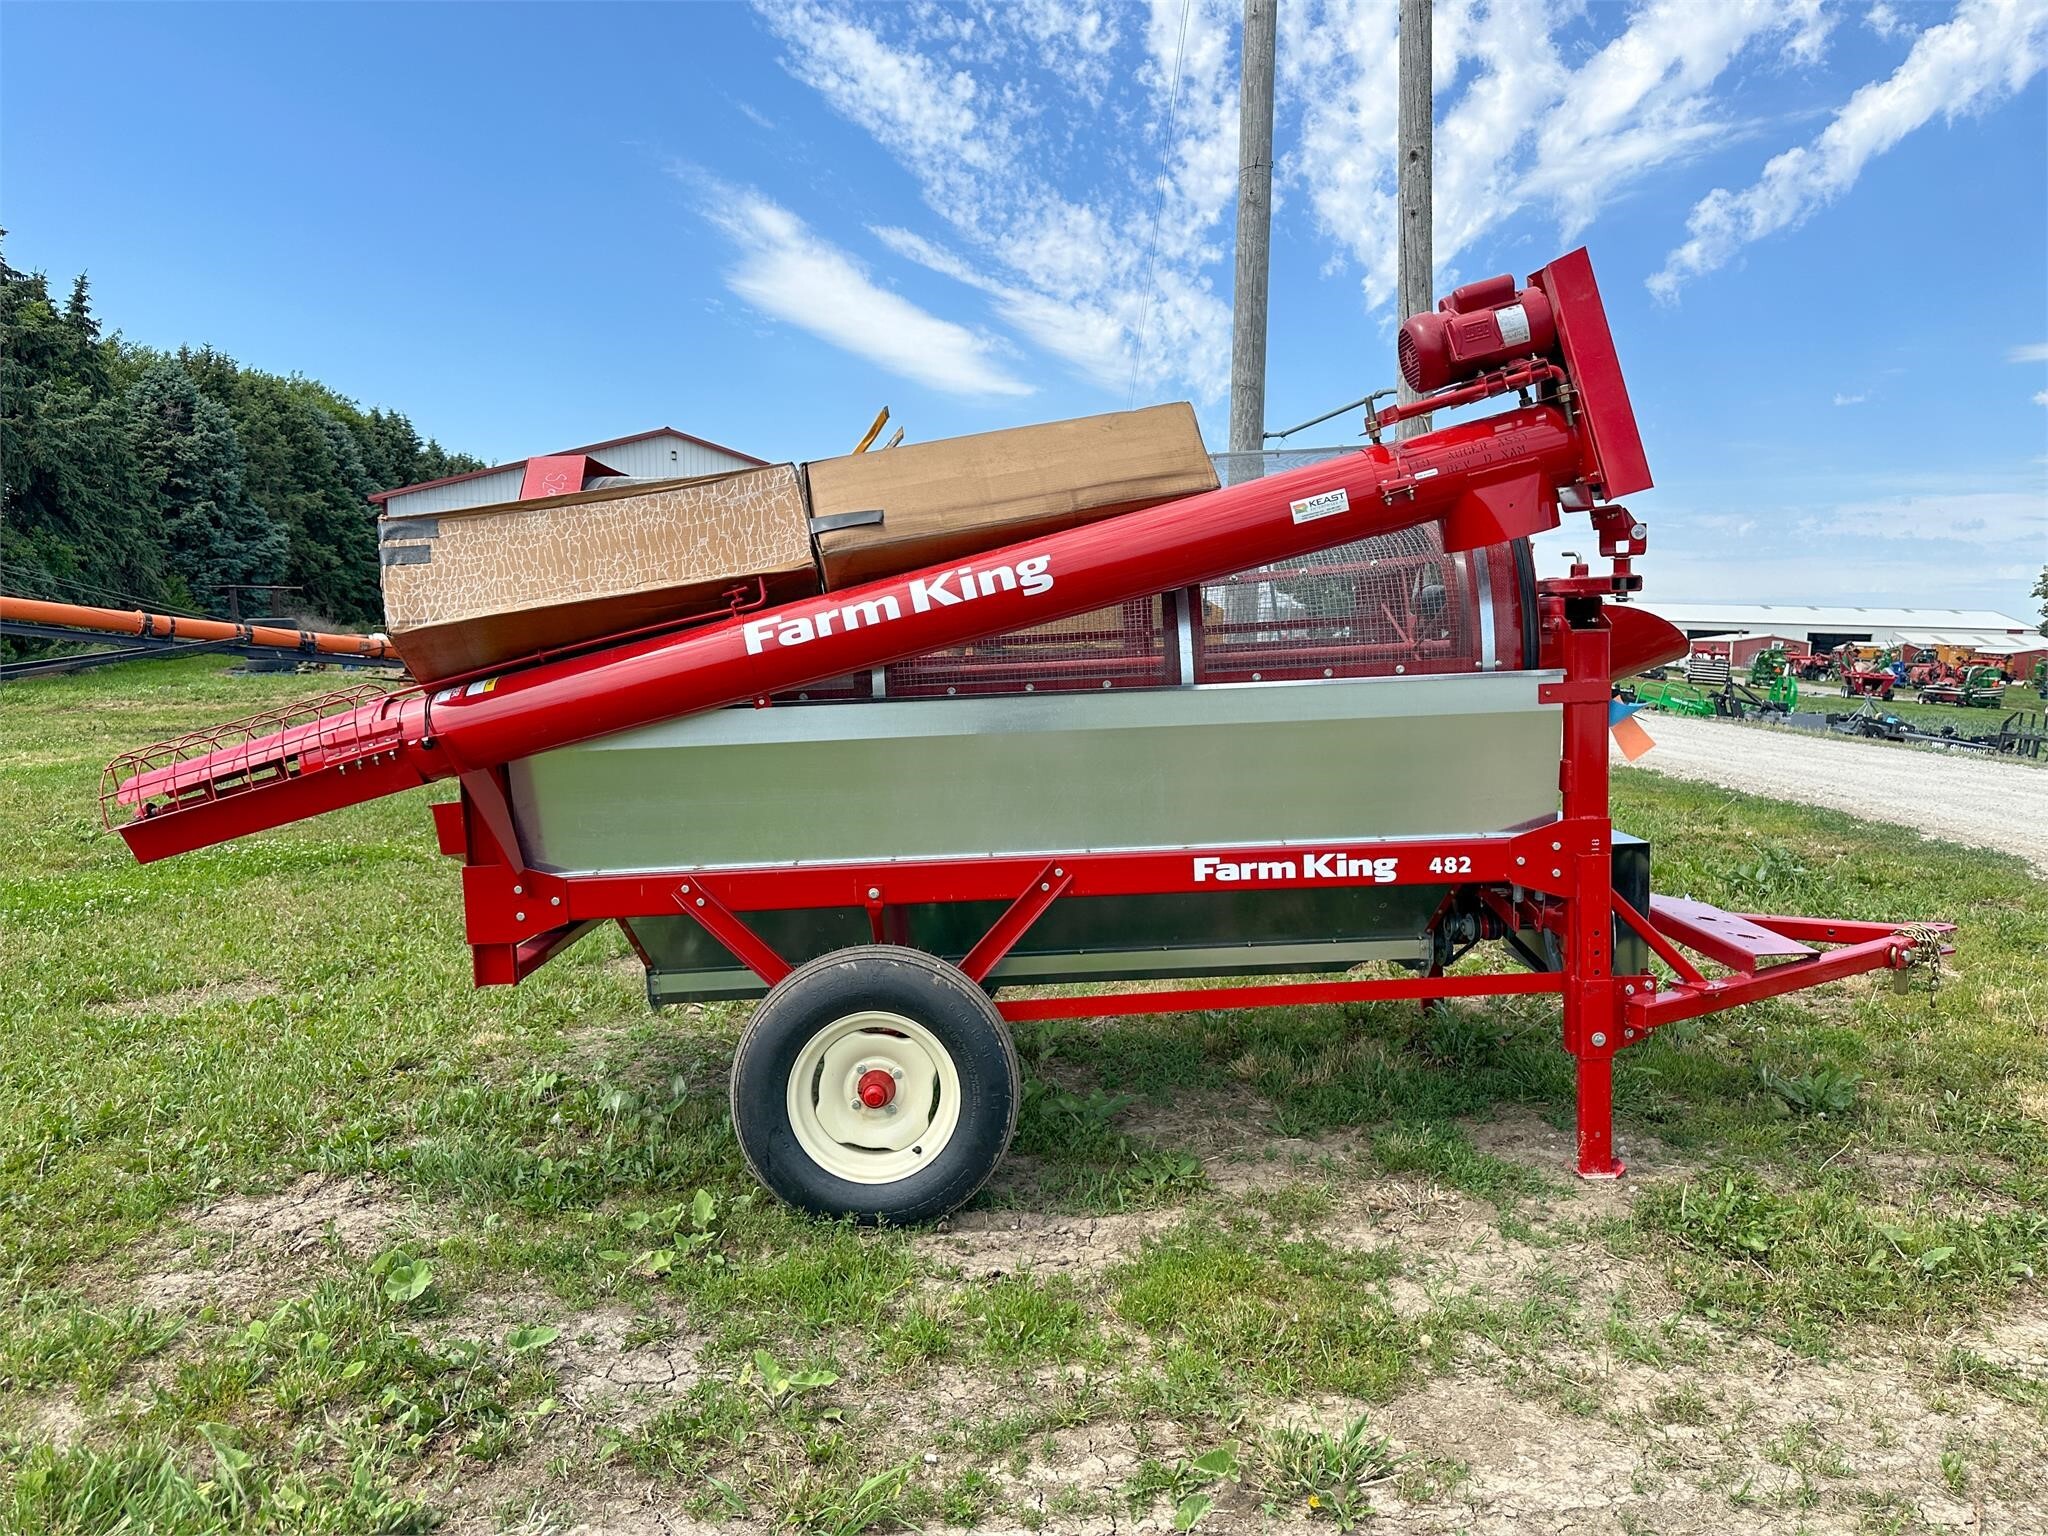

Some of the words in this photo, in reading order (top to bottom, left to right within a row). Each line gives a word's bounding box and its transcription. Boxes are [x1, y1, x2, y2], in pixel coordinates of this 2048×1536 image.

[1308, 492, 1345, 507] KEAST
[743, 594, 902, 655] Farm
[908, 555, 1054, 614] King
[1193, 857, 1296, 881] Farm
[1303, 853, 1398, 883] King
[1429, 856, 1472, 874] 482
